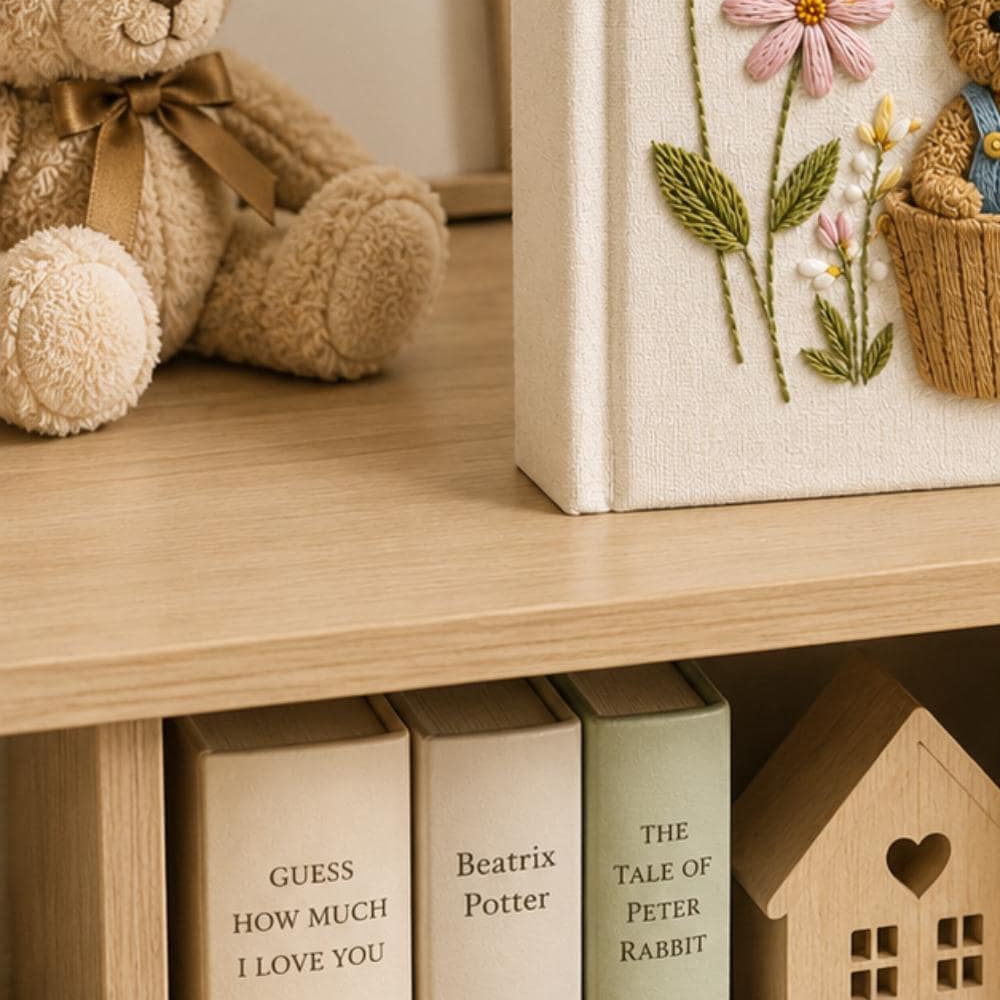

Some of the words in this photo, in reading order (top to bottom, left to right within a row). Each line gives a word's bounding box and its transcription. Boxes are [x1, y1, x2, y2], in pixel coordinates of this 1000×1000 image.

[640, 821, 689, 845] THE
[269, 859, 354, 888] GUESS
[456, 845, 556, 878] Beatrix
[613, 862, 675, 886] TALE
[682, 856, 712, 880] OF
[232, 909, 300, 934] HOW
[308, 897, 388, 927] MUCH
[464, 889, 551, 918] Potter
[626, 897, 701, 924] PETER
[237, 957, 248, 978] I
[255, 950, 324, 977] LOVE
[332, 942, 385, 967] YOU
[619, 933, 708, 963] RABBIT
